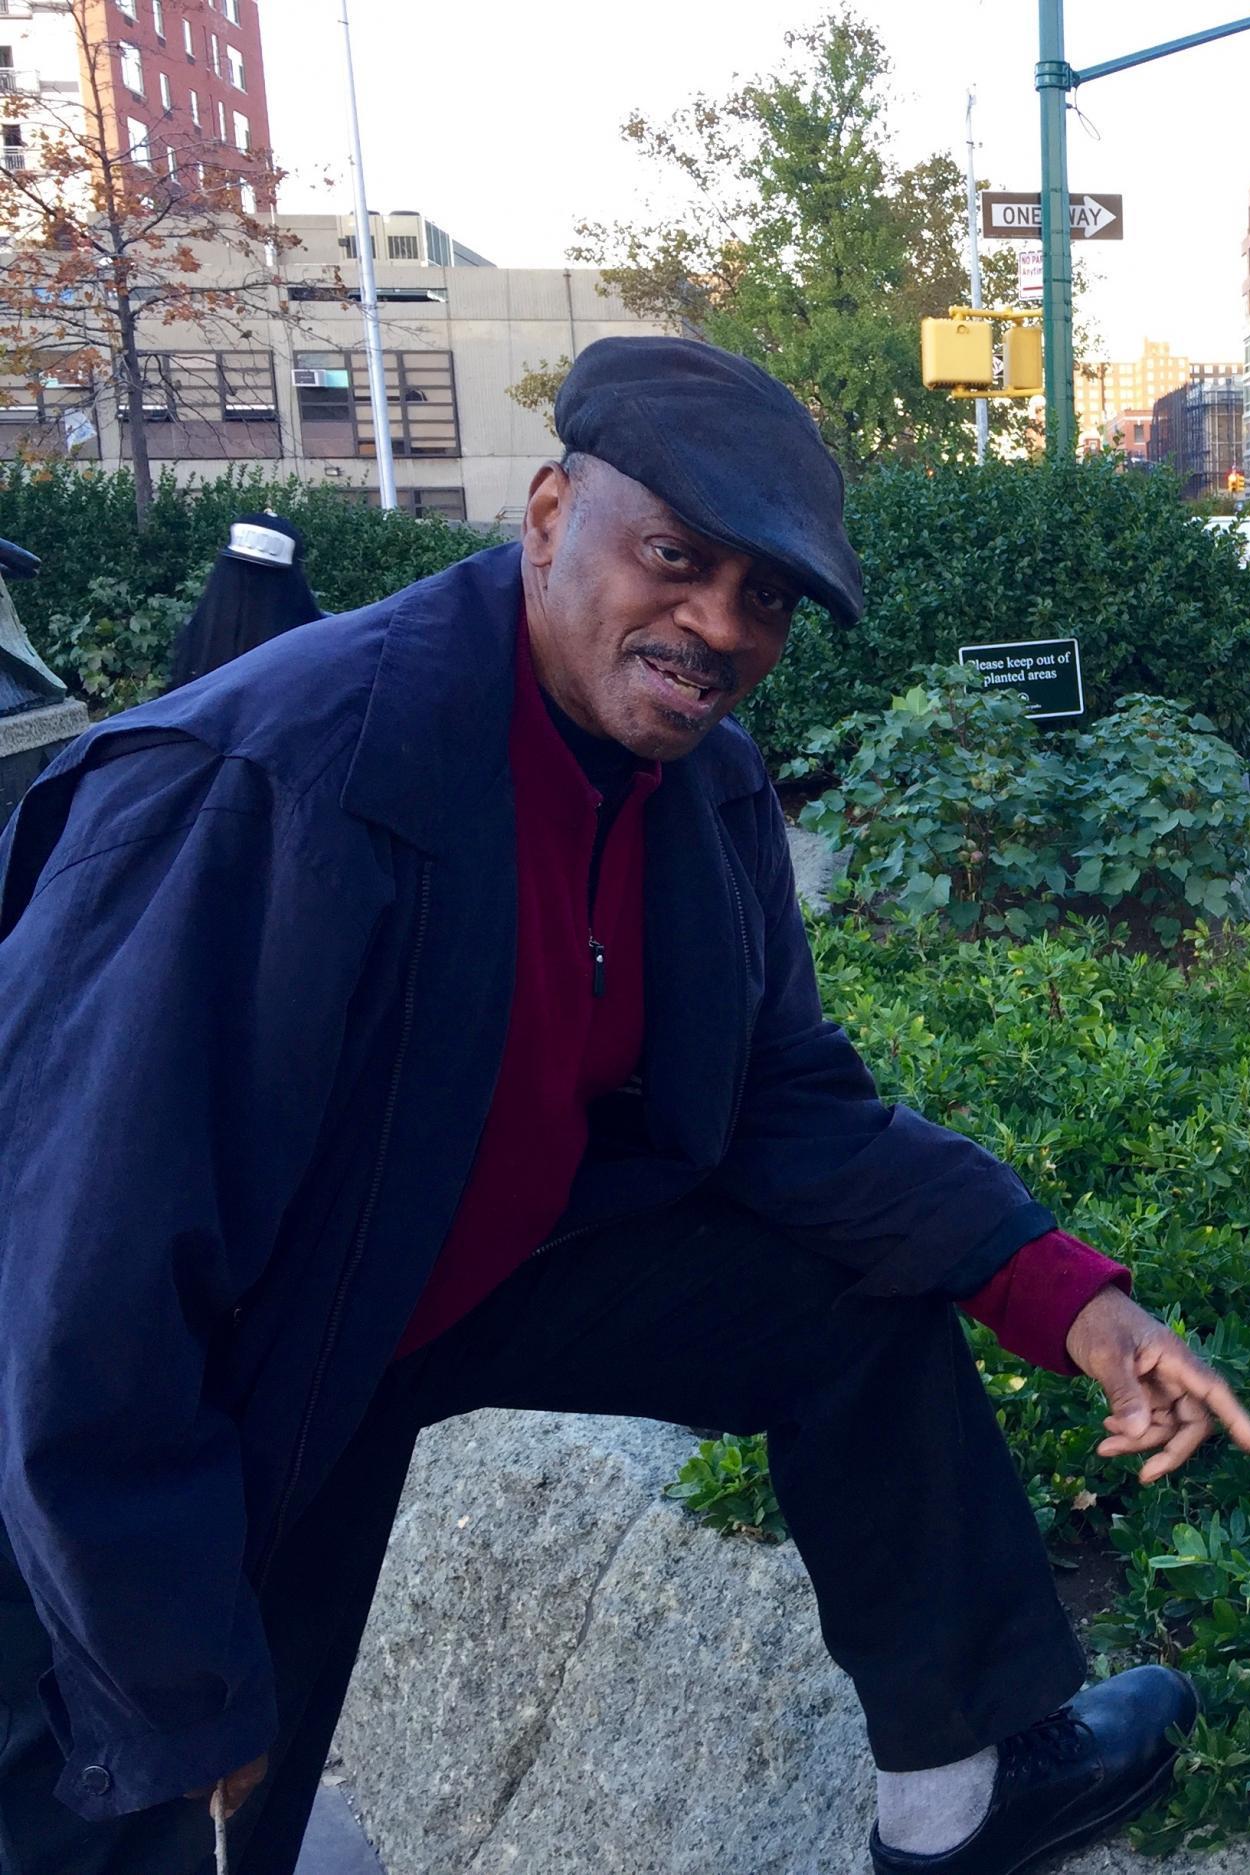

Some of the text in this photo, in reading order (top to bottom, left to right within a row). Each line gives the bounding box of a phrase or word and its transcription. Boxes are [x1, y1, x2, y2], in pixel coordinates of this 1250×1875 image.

[1003, 206, 1042, 225] ONE
[1022, 255, 1031, 265] NO
[1006, 656, 1034, 669] keep
[1036, 653, 1055, 666] out
[1057, 651, 1071, 664] of
[984, 669, 1057, 687] planted areas
